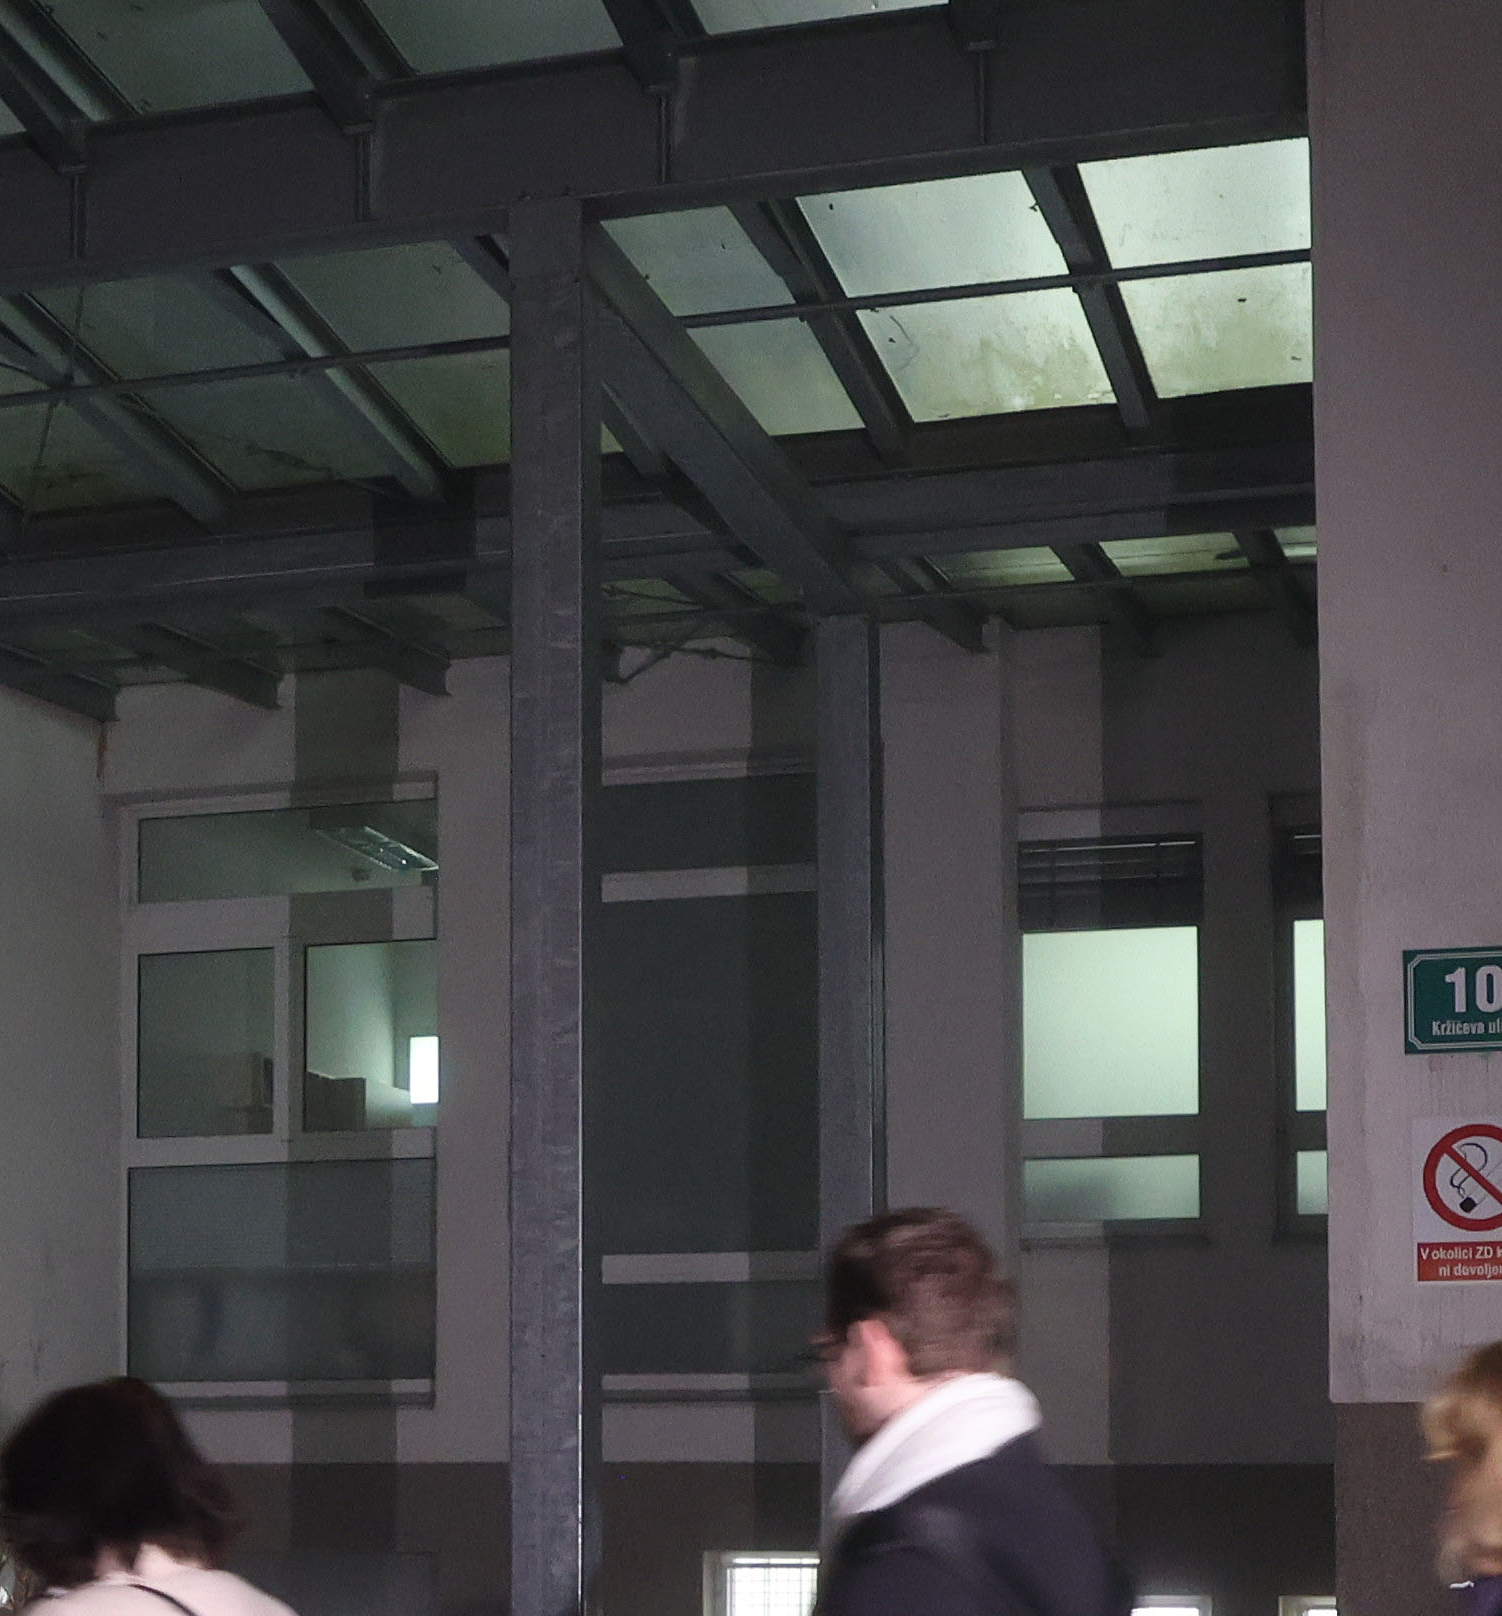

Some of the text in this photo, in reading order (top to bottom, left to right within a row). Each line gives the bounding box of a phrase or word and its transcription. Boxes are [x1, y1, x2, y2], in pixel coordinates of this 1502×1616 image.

[1432, 1019, 1485, 1036] Kržičeva
[1420, 1247, 1430, 1260] V
[1431, 1246, 1472, 1259] okolici
[1475, 1246, 1493, 1259] ZD
[1439, 1264, 1450, 1277] ni
